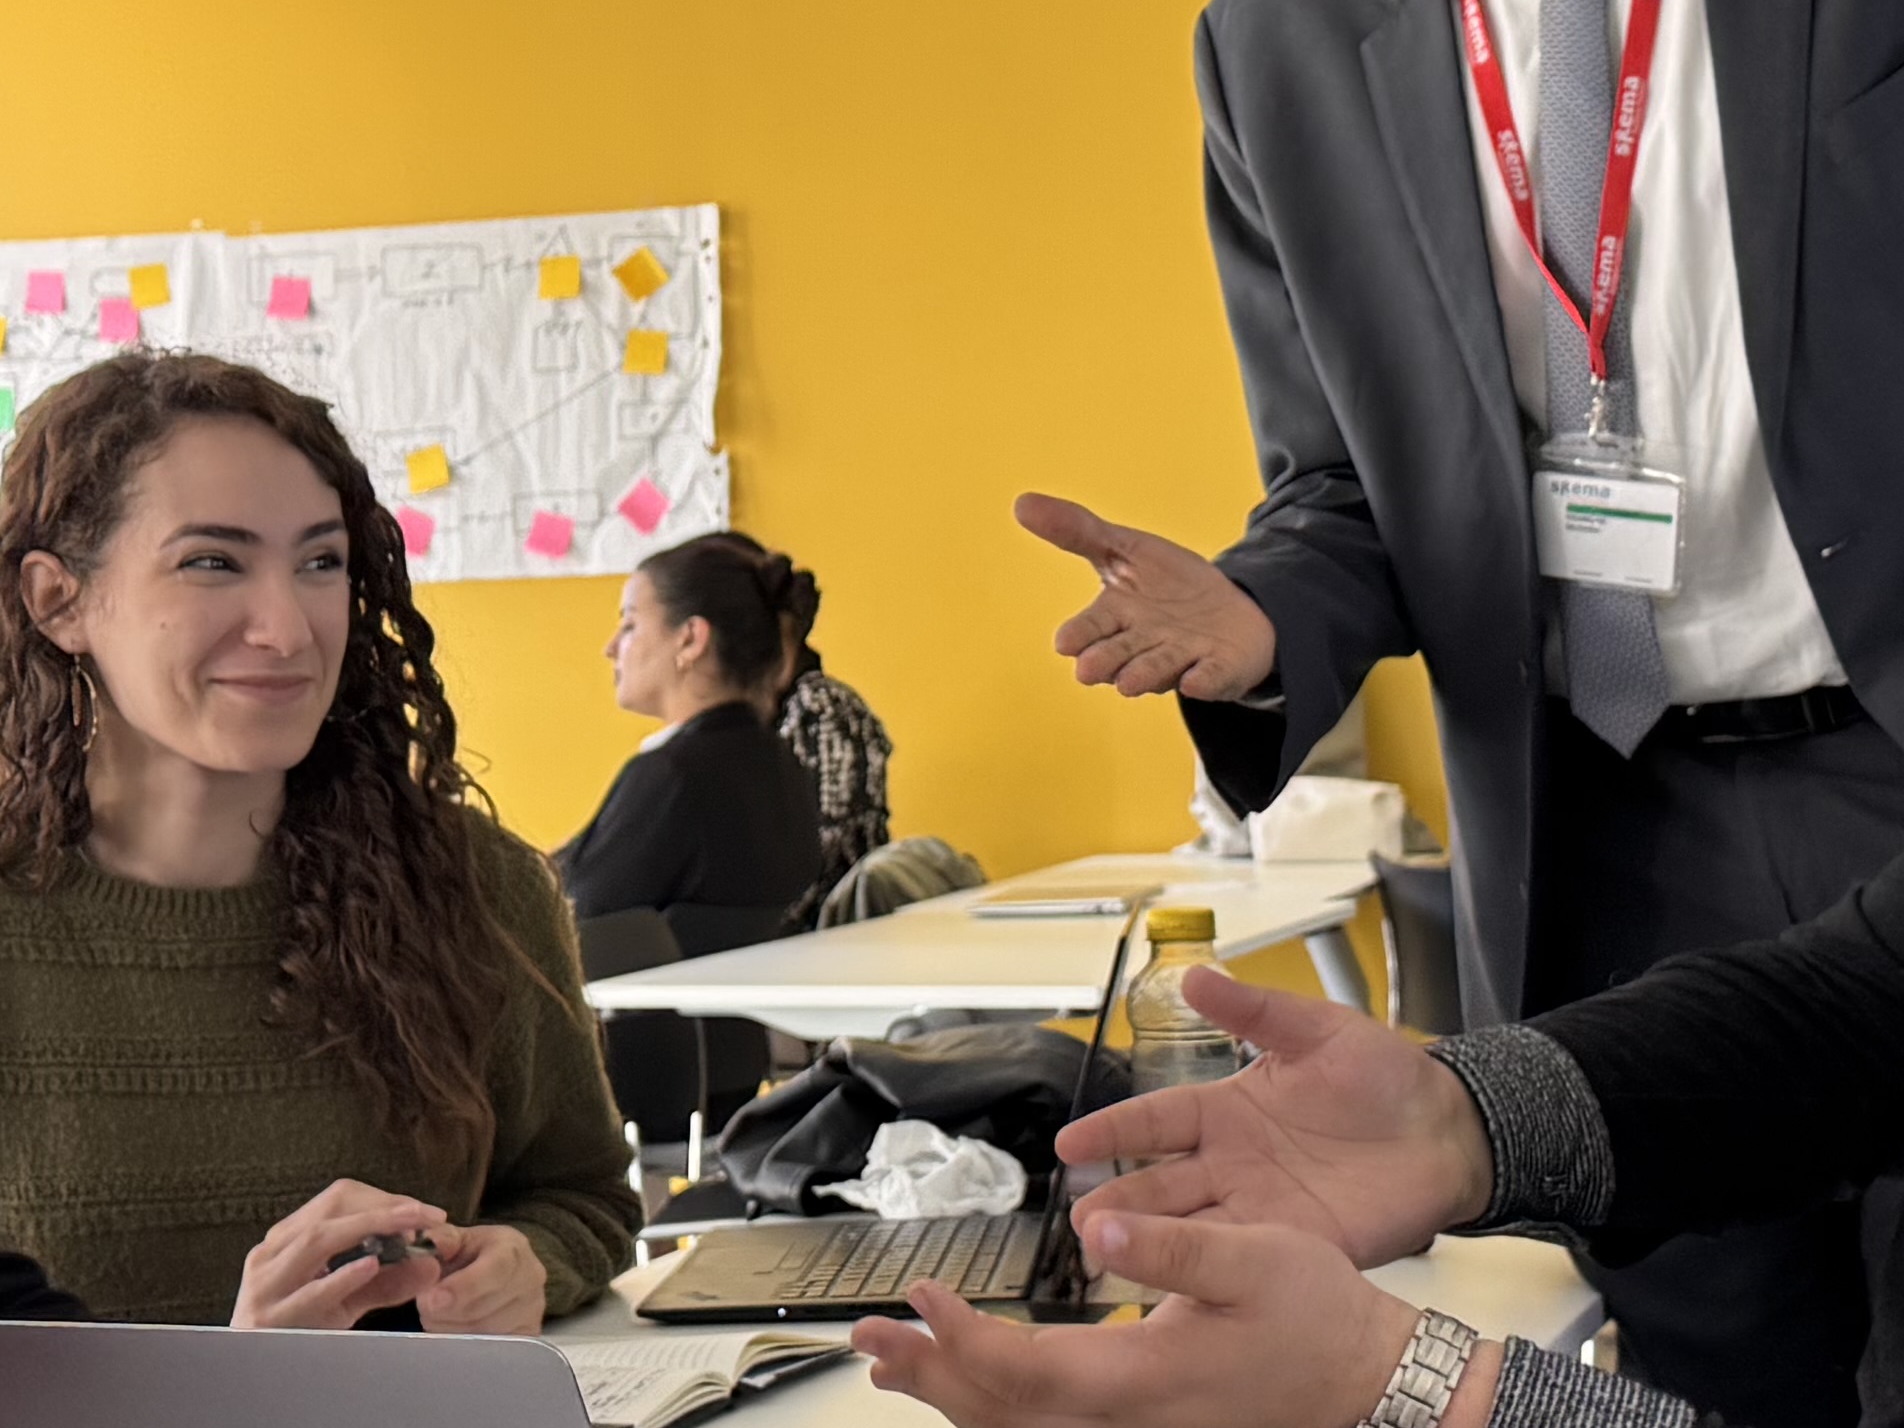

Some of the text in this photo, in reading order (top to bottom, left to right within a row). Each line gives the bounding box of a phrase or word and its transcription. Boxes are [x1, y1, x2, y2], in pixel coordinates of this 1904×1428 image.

[1614, 75, 1641, 157] skema
[1496, 129, 1529, 202] skema
[1550, 479, 1611, 499] skema
